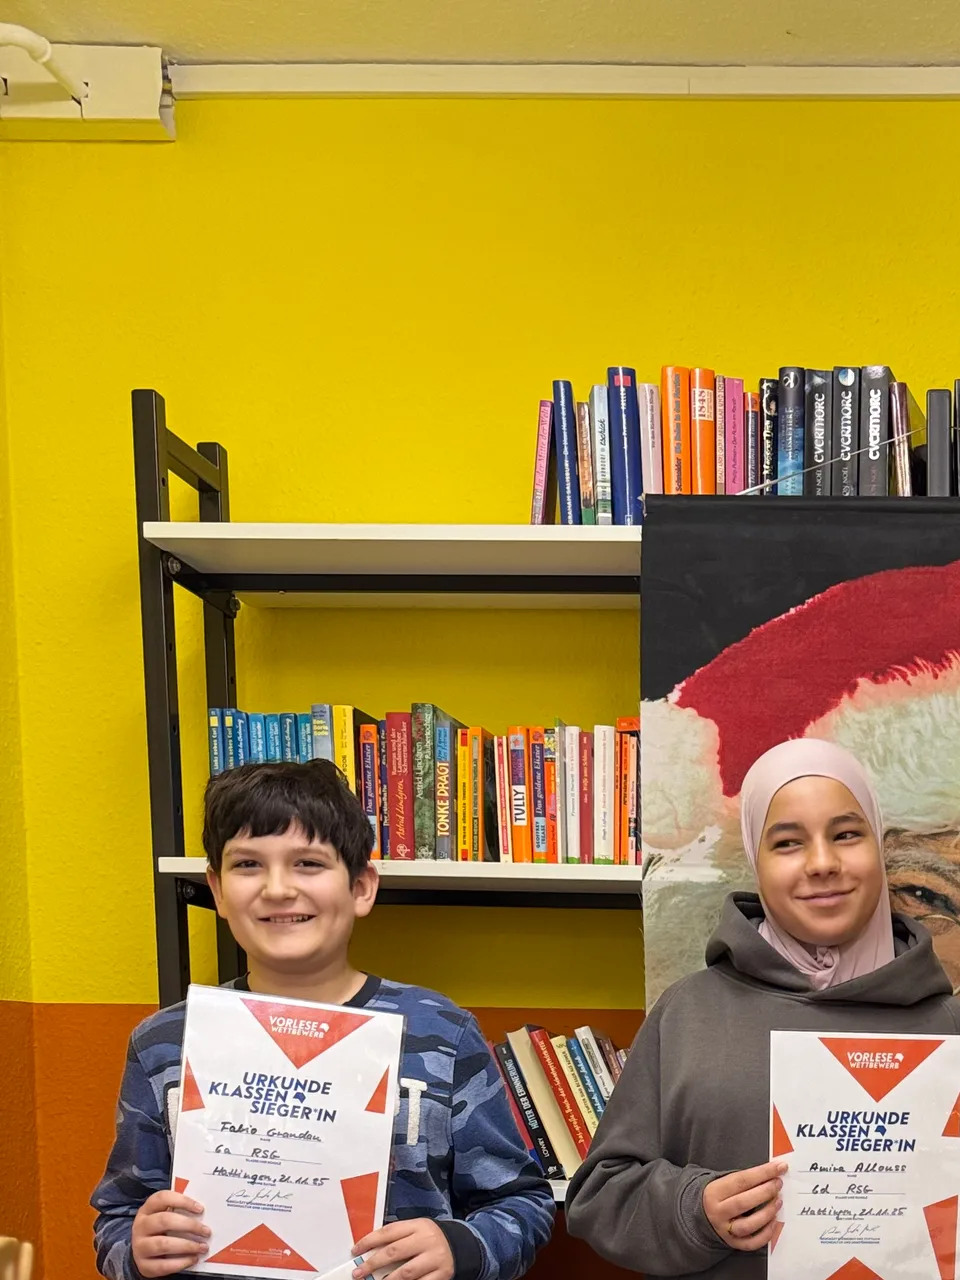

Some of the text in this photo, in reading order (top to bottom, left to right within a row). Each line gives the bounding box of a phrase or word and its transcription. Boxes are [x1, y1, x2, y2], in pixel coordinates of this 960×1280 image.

[698, 390, 706, 418] 1848
[541, 408, 549, 425] Welt
[539, 427, 548, 440] der
[598, 418, 606, 446] tschick
[537, 442, 547, 462] Mitte
[536, 464, 544, 477] der
[424, 714, 432, 759] Räubertochter
[363, 744, 371, 769] Elixier
[533, 745, 541, 769] Elixier
[365, 770, 374, 797] goldene
[535, 771, 543, 799] goldene
[395, 778, 407, 839] Astrid Lindgren
[436, 761, 449, 836] TONKE DRAGT
[513, 789, 525, 822] TULLY
[269, 1016, 318, 1031] VORLESE
[271, 1026, 324, 1038] WETTBEWERB
[847, 1052, 893, 1062] VORLESE
[849, 1061, 899, 1069] WETTBEWERB
[209, 1081, 288, 1103] KLASSEN
[243, 1072, 332, 1095] URKUNDE
[504, 1059, 550, 1158] LOWRY HÜTER DER ERINNERUNG
[827, 1111, 910, 1125] URKUNDE
[221, 1121, 257, 1135] Fabio
[796, 1125, 870, 1137] KLASSEN
[214, 1145, 280, 1160] 6a RSG
[809, 1163, 846, 1172] Amira
[846, 1184, 873, 1194] RSG
